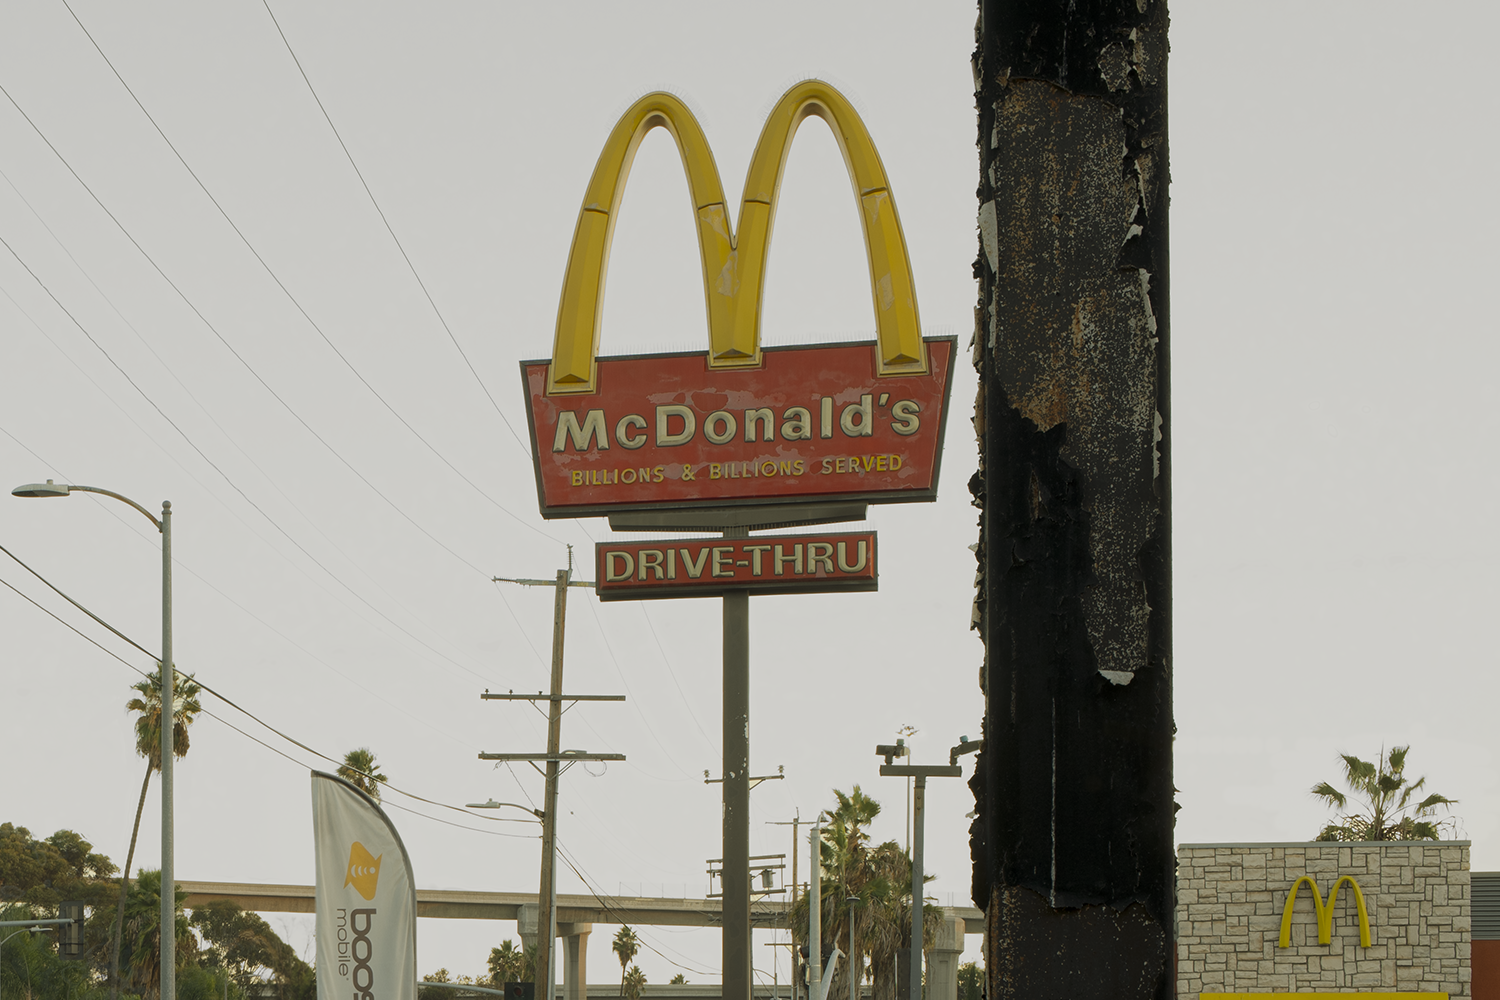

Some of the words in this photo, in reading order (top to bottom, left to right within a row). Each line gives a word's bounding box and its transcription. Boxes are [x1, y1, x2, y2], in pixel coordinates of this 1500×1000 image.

[551, 392, 922, 454] McDonald's
[571, 466, 666, 487] BILLIONS
[681, 465, 696, 482] &
[709, 459, 805, 480] BILLIONS
[820, 454, 903, 476] SERVED
[604, 540, 868, 583] DRIVE-THRU
[337, 908, 351, 977] mobile
